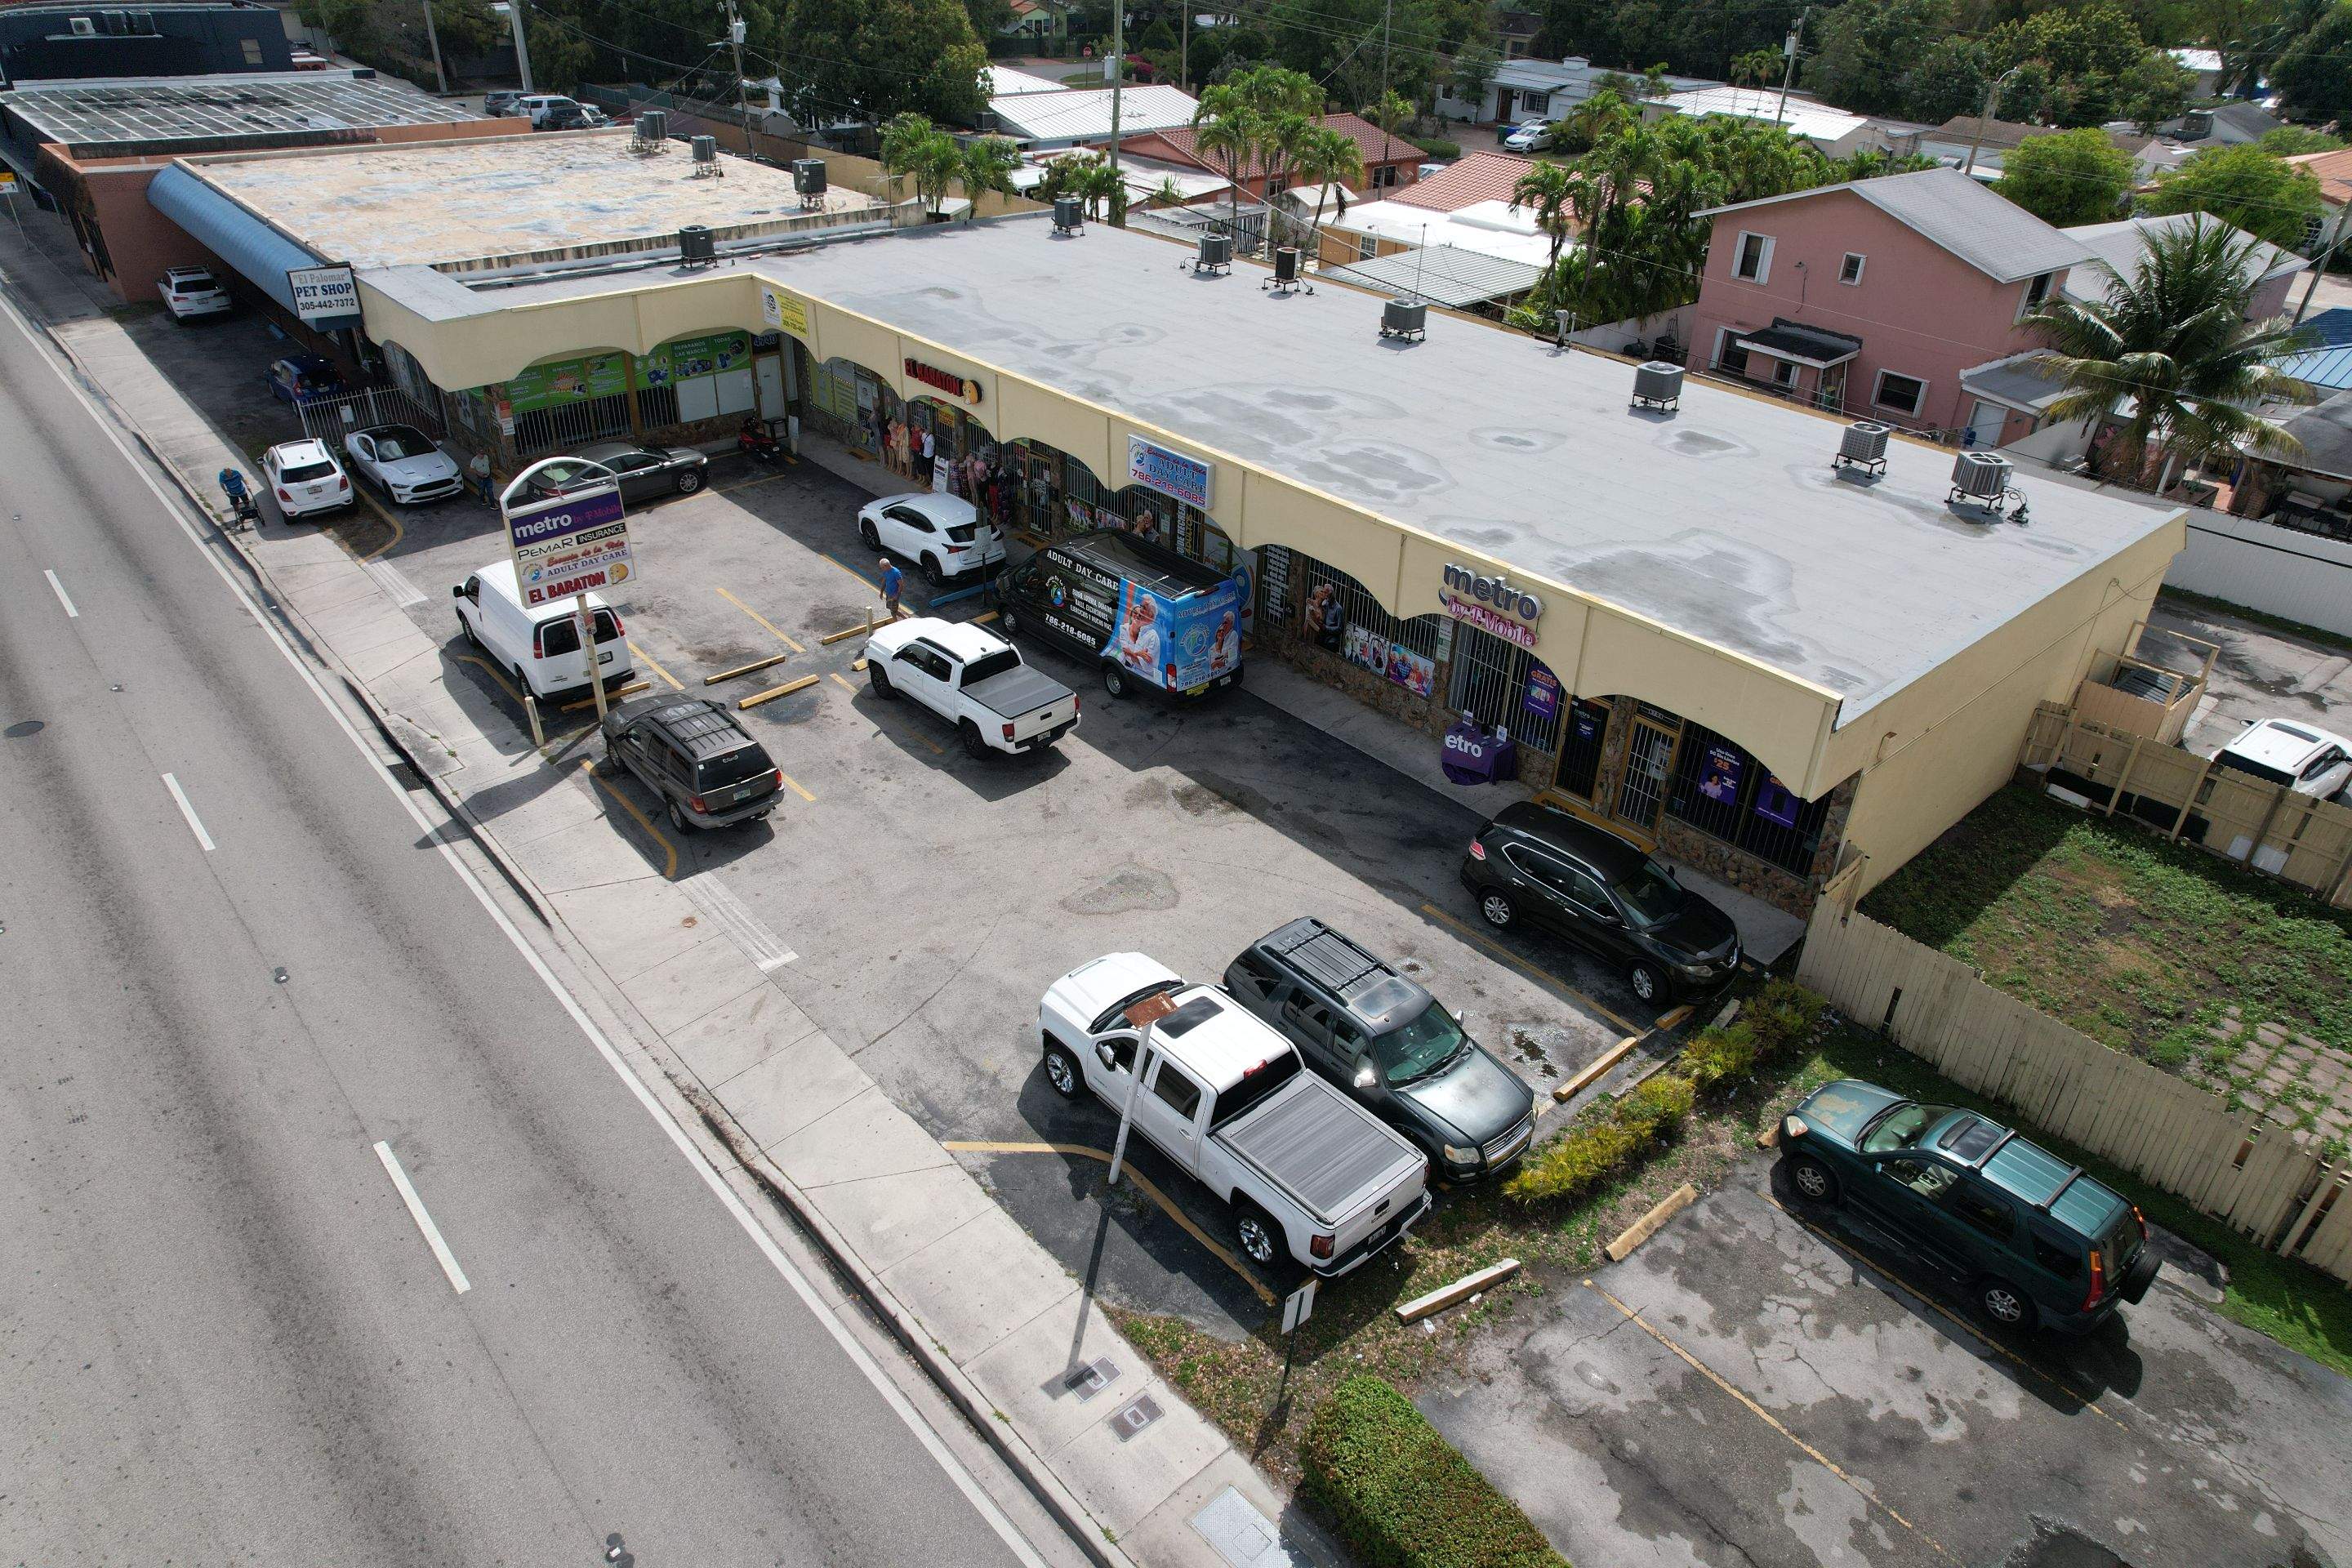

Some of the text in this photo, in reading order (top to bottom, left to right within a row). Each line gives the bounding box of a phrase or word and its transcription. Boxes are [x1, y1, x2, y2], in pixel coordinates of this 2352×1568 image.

[295, 283, 352, 298] PET SHOP
[300, 298, 355, 310] 305-442-7372
[1149, 464, 1207, 494] DAY CARE
[1159, 458, 1197, 479] ADULT
[1131, 468, 1205, 506] 786-218-6085
[514, 513, 572, 538] metro
[578, 524, 625, 543] INSURANCE
[547, 562, 579, 577] ADULT
[581, 555, 600, 568] DAY
[602, 550, 628, 561] CARE
[1047, 550, 1119, 590] ADULT DAY CARE
[528, 570, 607, 604] EL BARATON
[1443, 562, 1542, 621] metro
[1045, 612, 1096, 645] 786-218-6085
[1447, 595, 1468, 621] by
[1469, 604, 1536, 648] T-Mobile
[1530, 670, 1557, 687] GRATIS
[1445, 734, 1482, 758] etro
